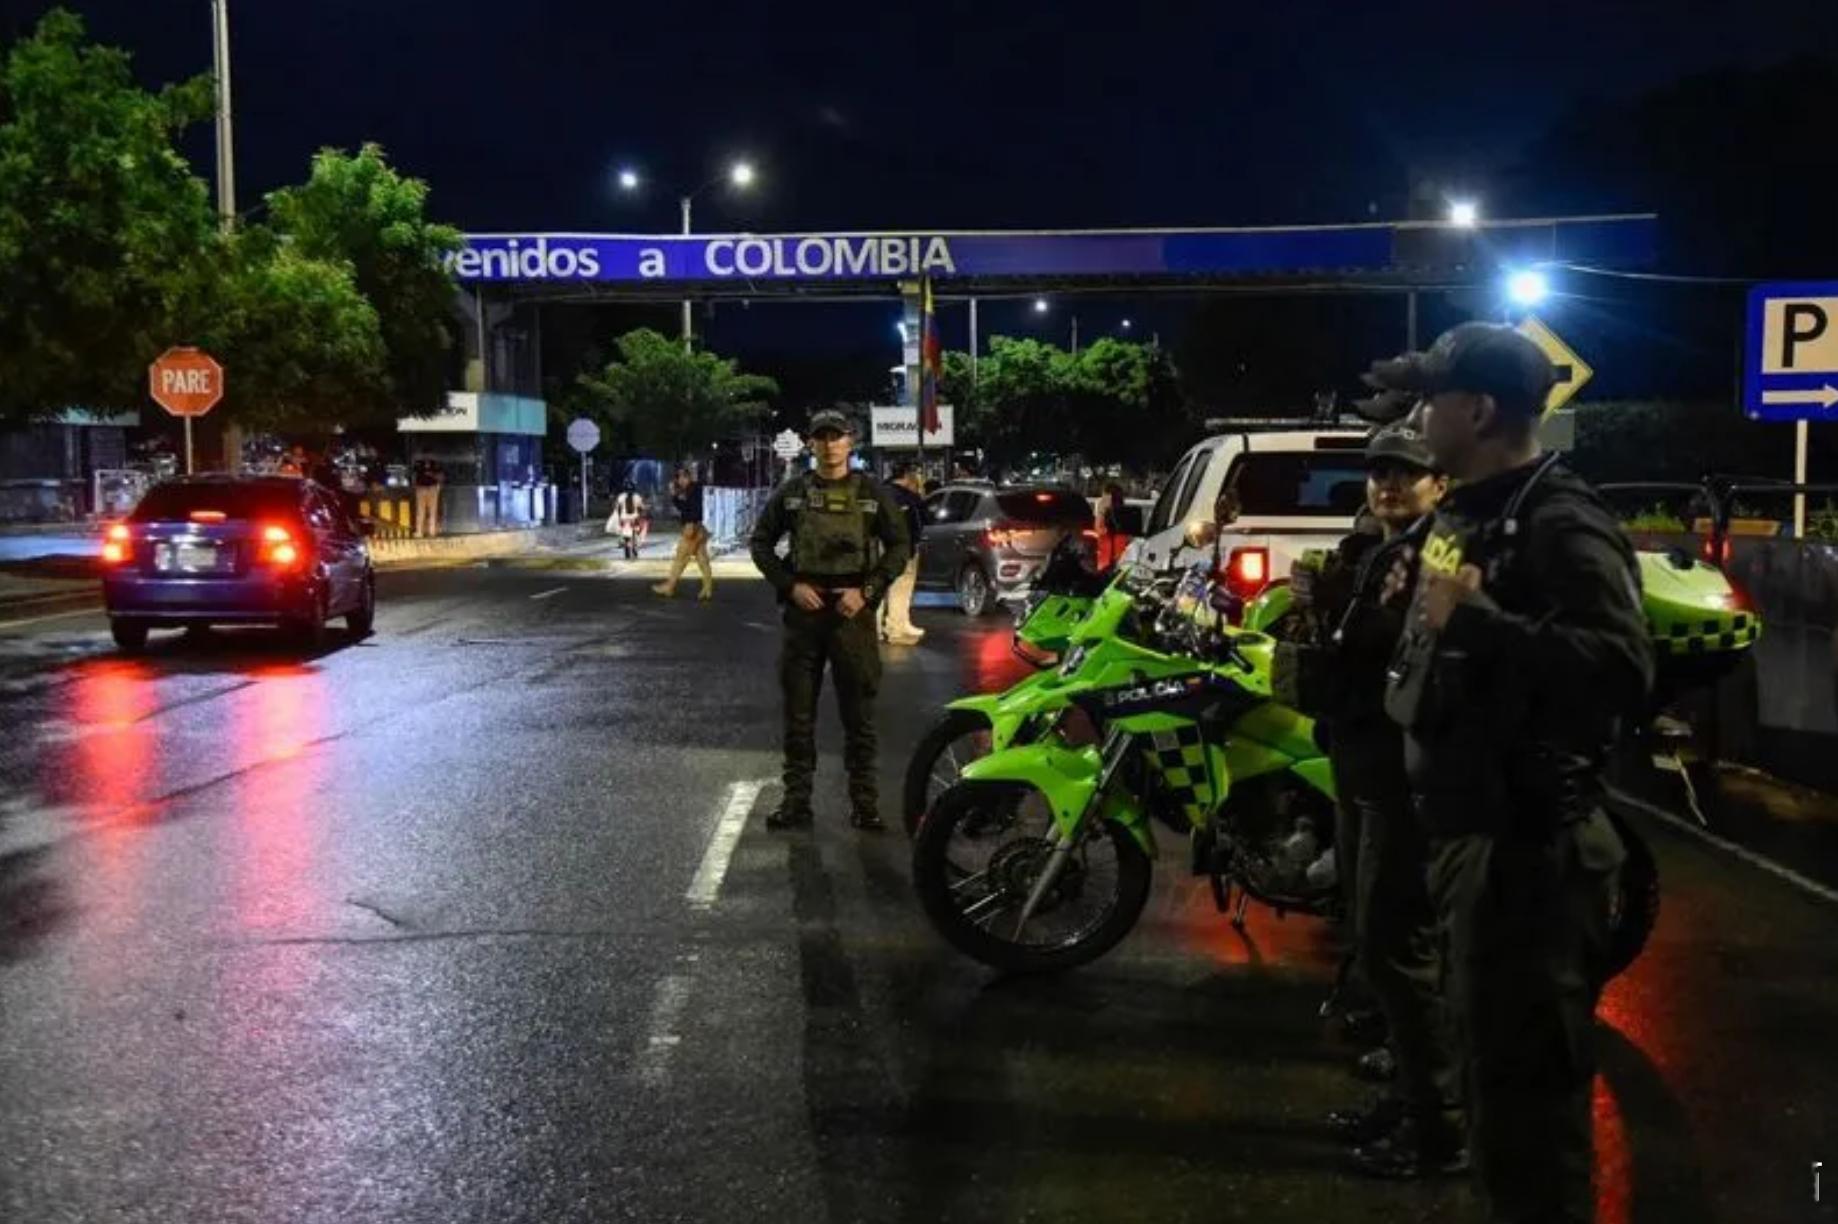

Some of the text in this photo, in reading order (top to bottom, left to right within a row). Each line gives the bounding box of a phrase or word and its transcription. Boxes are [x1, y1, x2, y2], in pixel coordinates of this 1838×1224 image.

[639, 248, 666, 277] a
[704, 237, 956, 276] COLOMBIA
[1781, 302, 1828, 368] P
[161, 368, 211, 394] PARE
